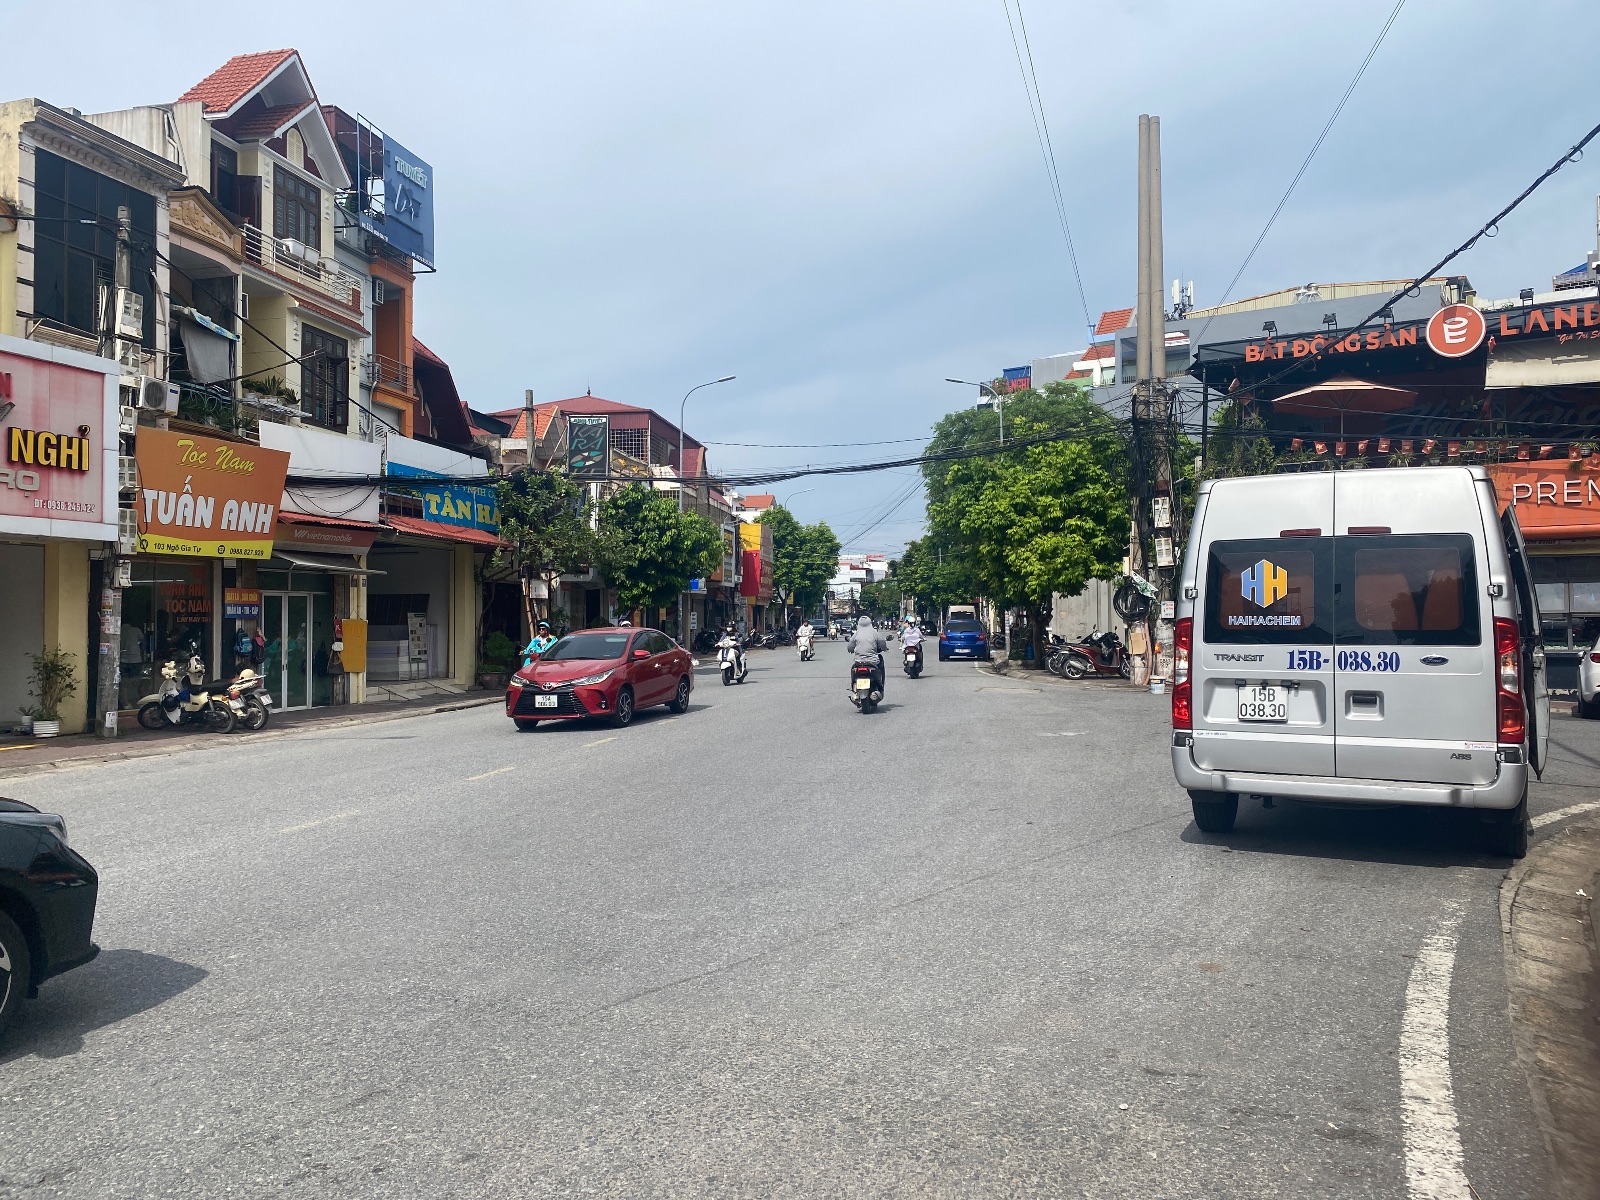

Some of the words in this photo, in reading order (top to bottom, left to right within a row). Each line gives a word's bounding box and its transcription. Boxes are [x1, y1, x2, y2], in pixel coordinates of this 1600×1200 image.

[1245, 336, 1288, 363] BẤT
[1291, 333, 1361, 361] ĐỘNG
[1366, 323, 1417, 350] SẢN
[9, 424, 91, 471] NGHỈ
[177, 439, 208, 464] Tóc
[214, 446, 255, 472] Nam
[142, 475, 215, 529] TUẤN
[221, 499, 274, 534] ANH
[425, 490, 472, 521] TÂN
[307, 530, 353, 543] vietnamobile
[154, 542, 165, 551] 103
[167, 543, 180, 553] Ngô
[189, 599, 211, 613] NAM
[1228, 615, 1302, 626] HAIHACHEM
[1214, 653, 1265, 662] TRANSIT
[1286, 650, 1330, 671] 15B-
[1337, 650, 1401, 673] 038.30
[1251, 687, 1276, 702] 15B
[1239, 703, 1286, 718] 038.30
[1450, 753, 1472, 761] ABS
